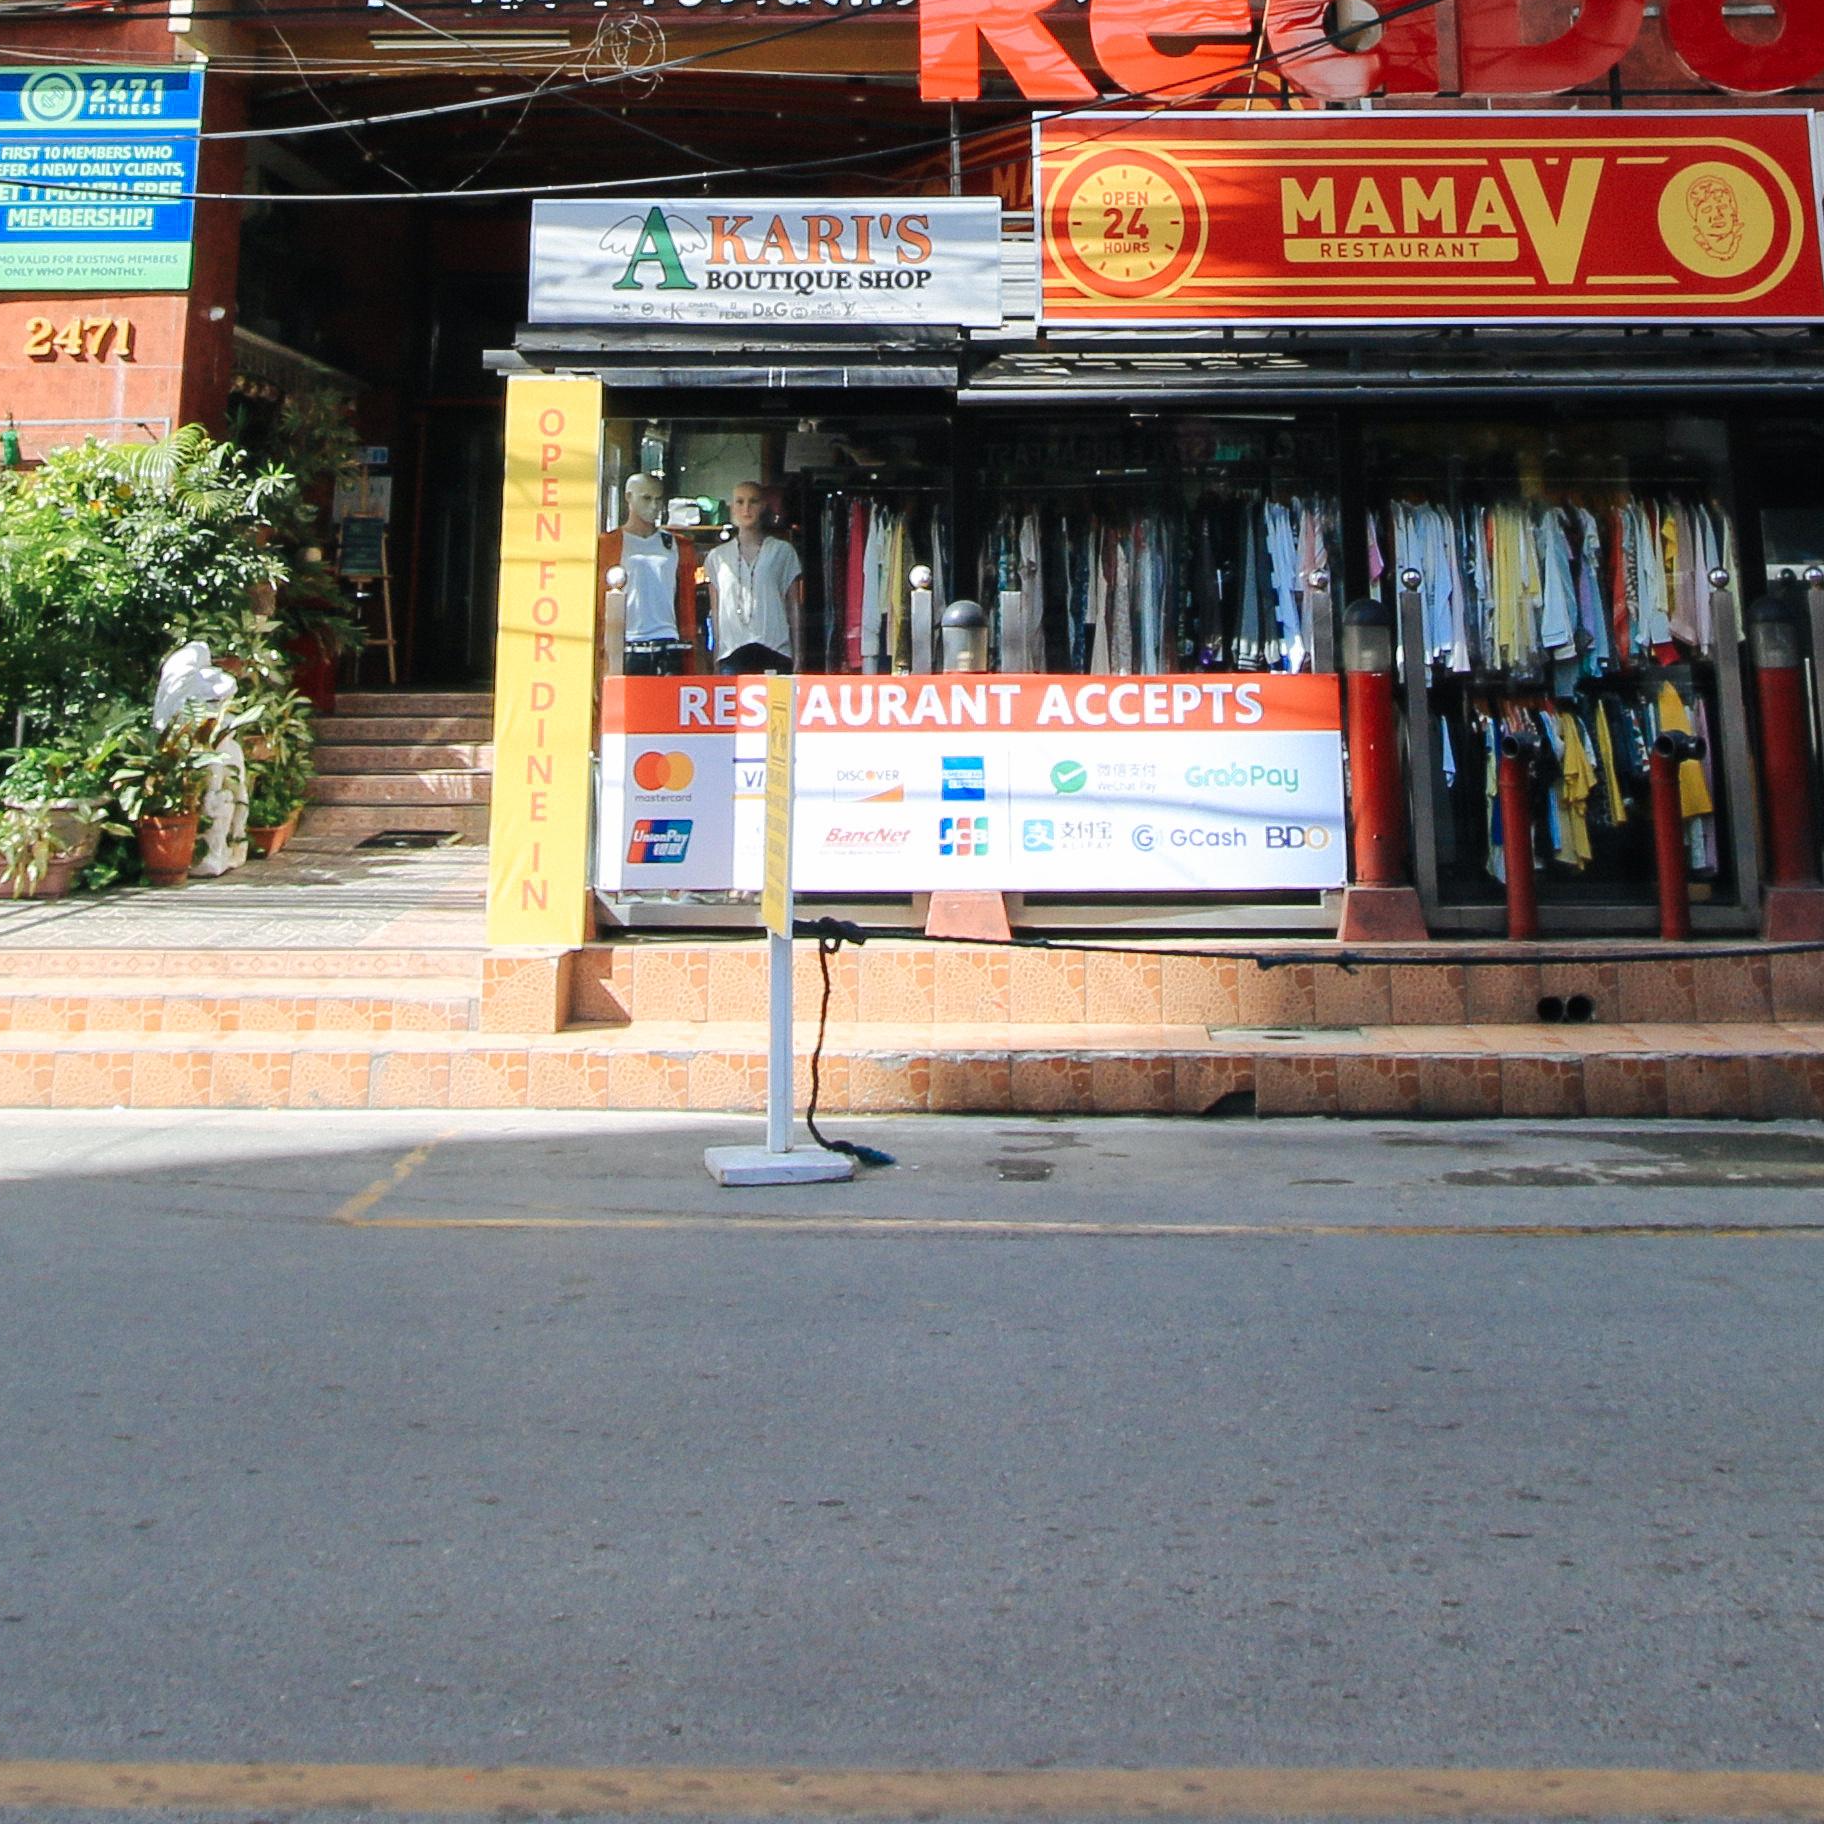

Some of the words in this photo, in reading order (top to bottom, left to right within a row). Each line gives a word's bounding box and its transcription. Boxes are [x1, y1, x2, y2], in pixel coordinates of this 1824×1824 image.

[89, 77, 165, 104] 2471
[88, 103, 162, 116] FITNESS
[1, 146, 41, 160] FIRST
[43, 146, 59, 160] 10
[62, 145, 131, 160] MEMBERS
[134, 145, 173, 160] WHO
[29, 163, 41, 177] 4
[42, 163, 78, 177] NEW
[80, 163, 123, 177] DAILY
[124, 162, 185, 178] CLIENTS,
[28, 182, 38, 202] 1
[44, 181, 127, 202] MONTH
[131, 181, 183, 202] FREE
[1102, 190, 1150, 208] OPEN
[7, 207, 155, 228] MEMBERSHIP!
[1103, 207, 1150, 240] 24
[1282, 176, 1519, 236] MAMA
[1500, 157, 1605, 285] V
[1103, 241, 1152, 255] HOURS
[1319, 242, 1482, 260] RESTAURANT
[17, 255, 51, 265] VALID
[52, 255, 74, 264] FOR
[76, 254, 125, 264] EXISTING
[127, 254, 179, 264] MEMBERS
[4, 267, 34, 277] ONLY
[36, 267, 65, 277] WHO
[66, 267, 88, 277] PAY
[89, 267, 147, 277] MONTHLY.
[705, 270, 853, 296] BOUTIQUE
[858, 270, 933, 290] SHOP
[752, 301, 788, 318] D&G
[23, 316, 131, 357] 2471
[535, 407, 567, 544] OPEN
[533, 558, 560, 665] FOR
[678, 683, 1030, 726] RESAURANT
[1037, 682, 1266, 725] ACCEPTS
[526, 683, 556, 823] DINE
[1096, 781, 1140, 793] WeChat
[1184, 761, 1299, 793] GrabPay
[634, 792, 693, 803] mastercard
[633, 829, 689, 846] UnionPay
[826, 828, 912, 844] BancNet
[1170, 827, 1248, 848] GCash
[1265, 824, 1330, 850] BDO
[521, 855, 549, 913] IN
